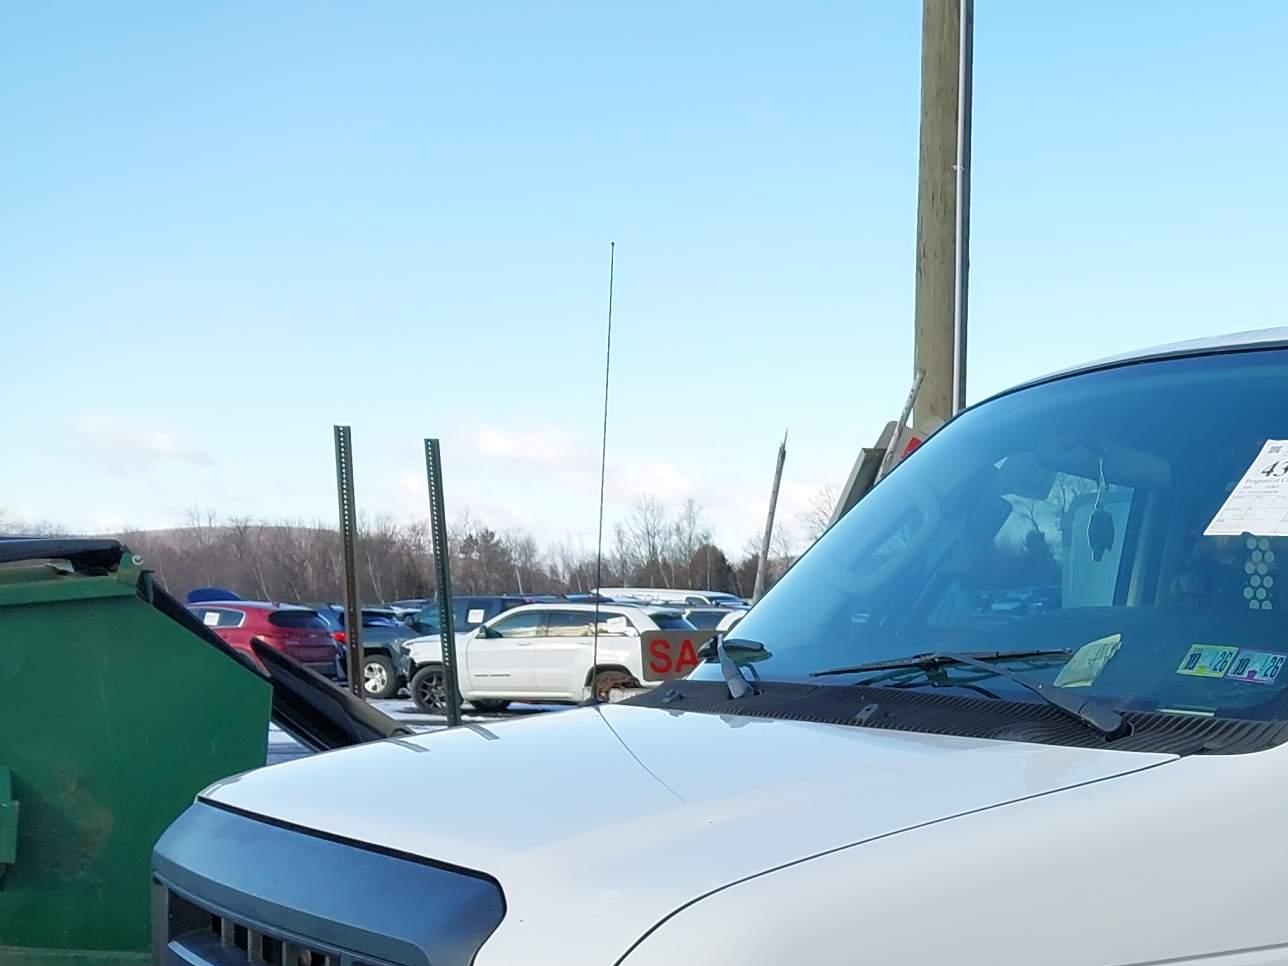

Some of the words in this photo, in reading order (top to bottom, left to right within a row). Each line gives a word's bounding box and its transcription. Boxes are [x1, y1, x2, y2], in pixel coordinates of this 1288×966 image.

[1185, 652, 1201, 670] 10
[1214, 651, 1233, 672] 26
[1233, 657, 1251, 675] 10
[1263, 656, 1284, 678] 26
